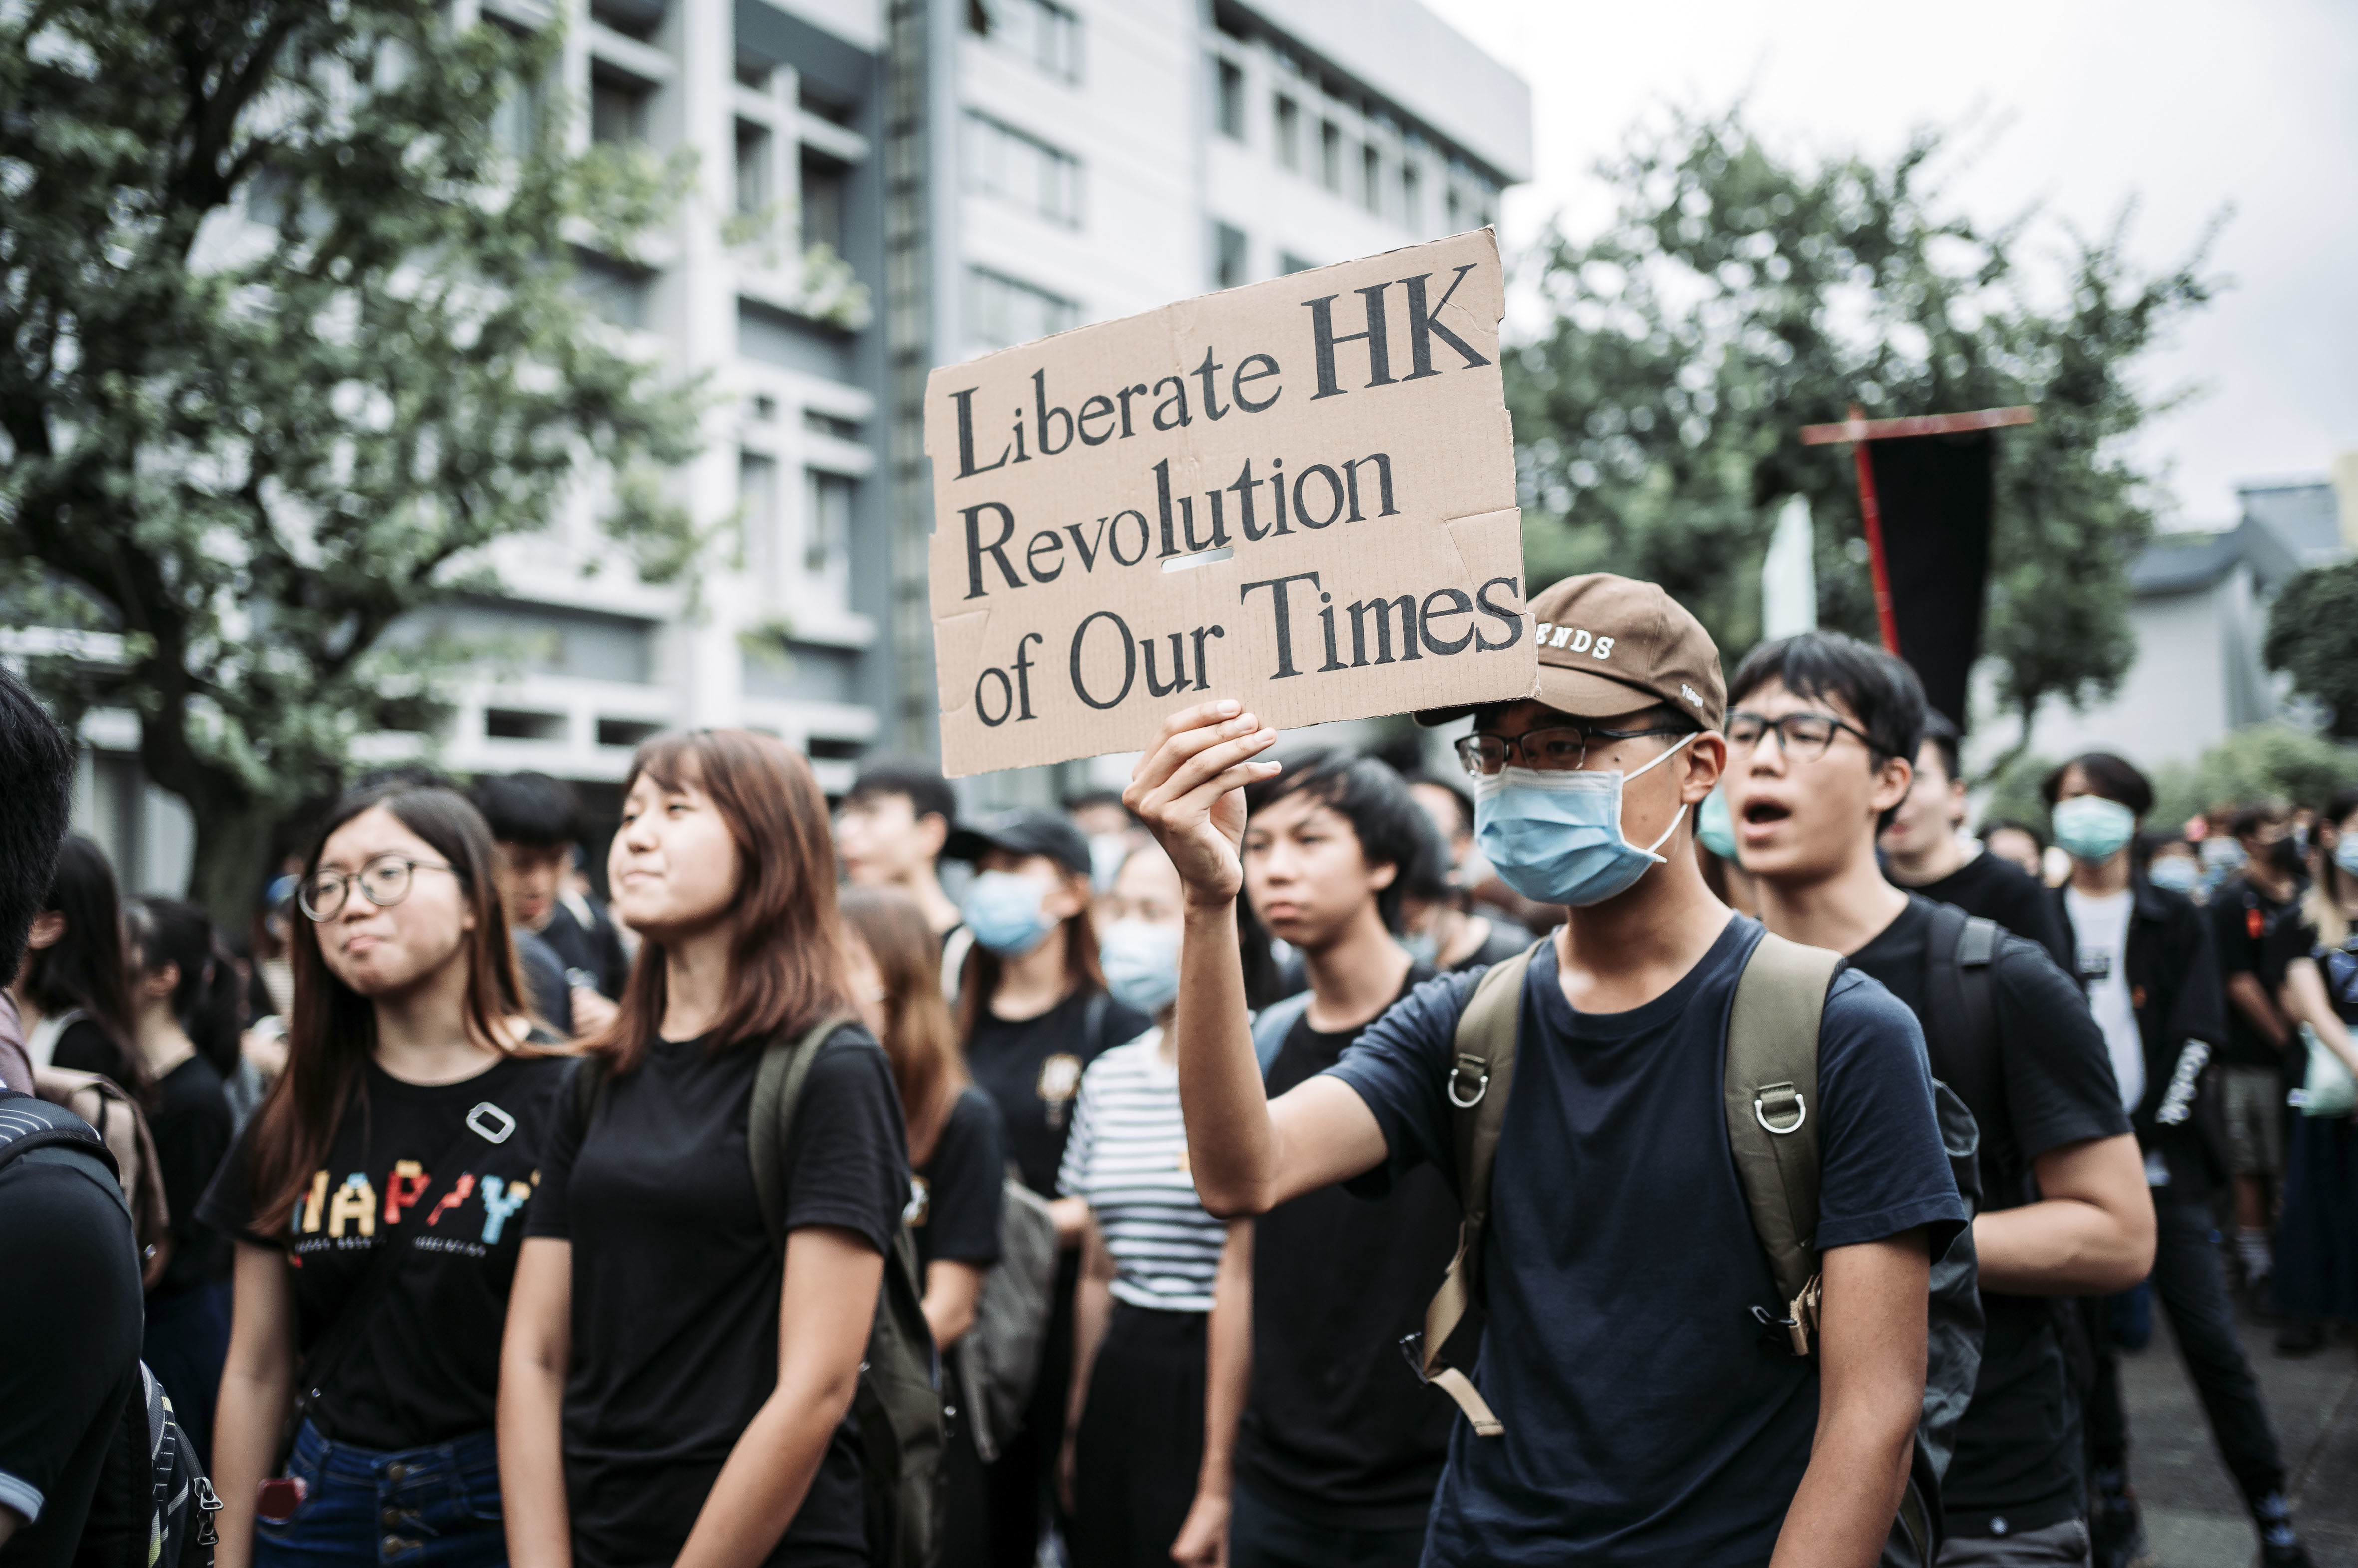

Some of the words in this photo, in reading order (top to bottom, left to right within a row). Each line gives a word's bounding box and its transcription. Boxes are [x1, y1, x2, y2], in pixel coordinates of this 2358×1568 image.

[949, 345, 1282, 480] Liberate
[1301, 262, 1492, 401] HK
[958, 452, 1401, 600] Revolution
[975, 632, 1043, 727] of
[1070, 610, 1225, 710] Our
[1240, 570, 1524, 680] Times
